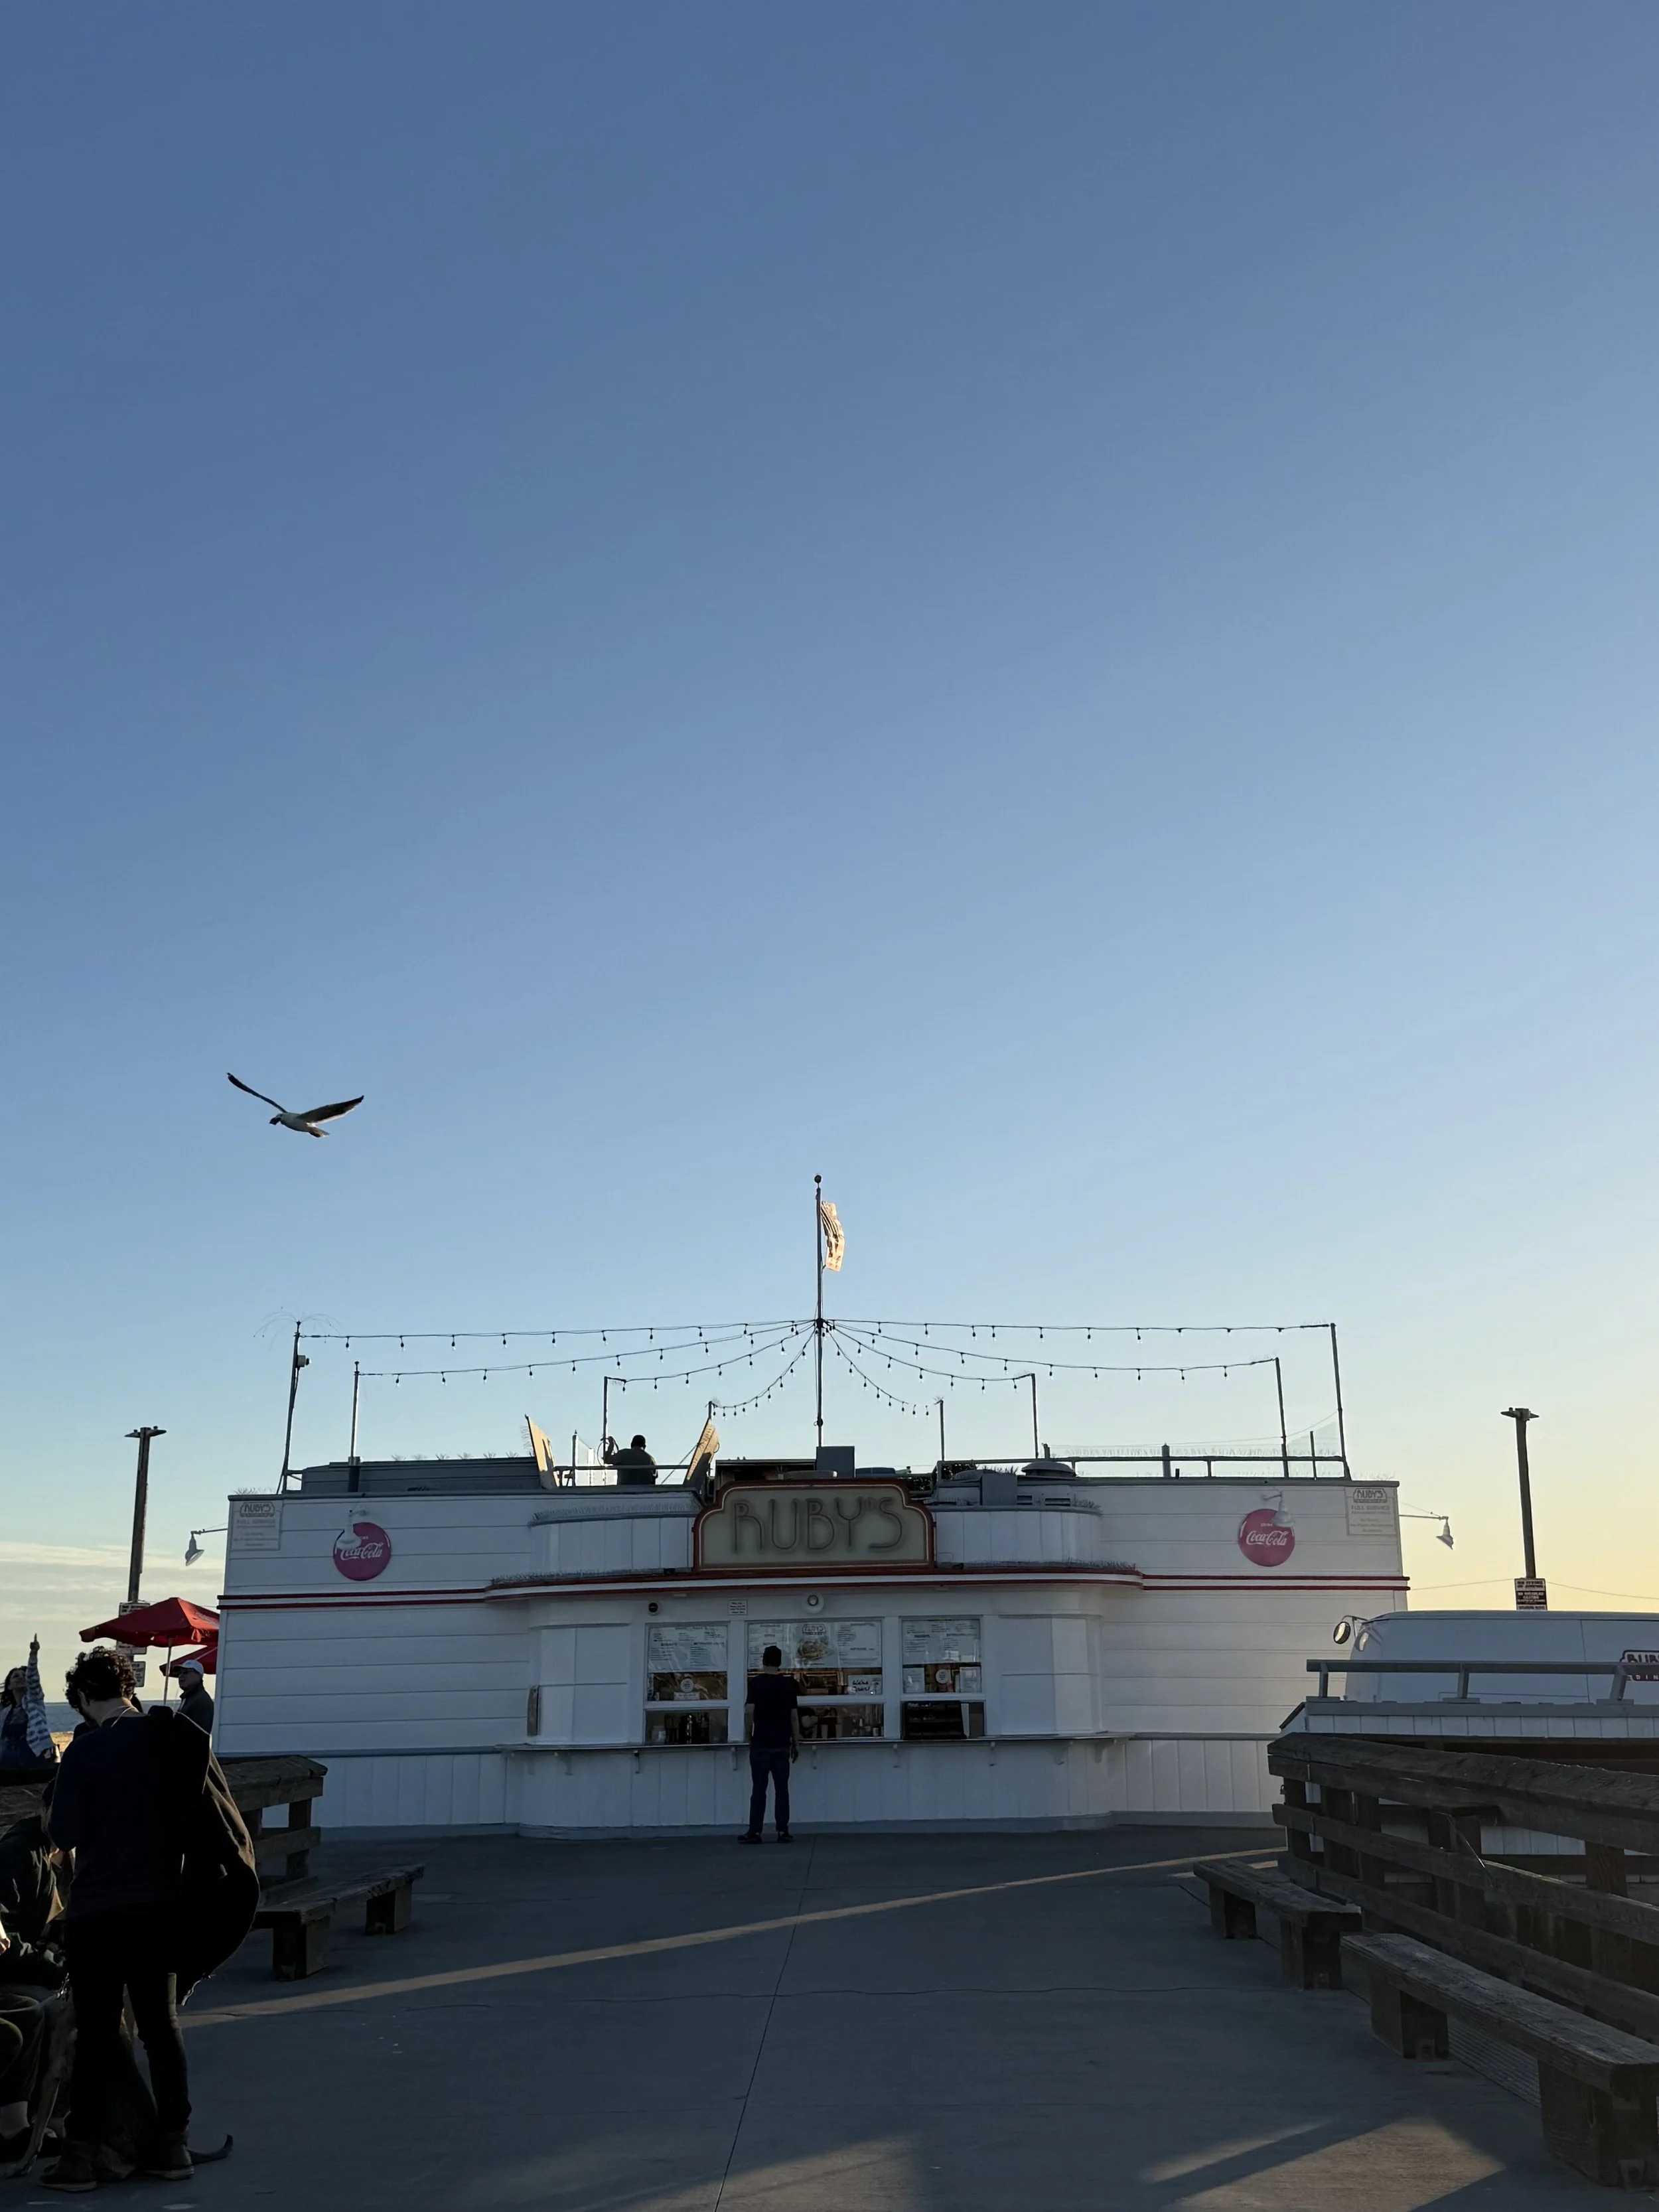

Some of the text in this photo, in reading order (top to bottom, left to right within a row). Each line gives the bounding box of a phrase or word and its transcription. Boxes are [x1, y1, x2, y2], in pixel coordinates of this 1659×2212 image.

[1356, 1490, 1384, 1499] RUBY'S
[732, 1497, 904, 1554] RUBY'S
[1246, 1530, 1289, 1546] Coca-Cola
